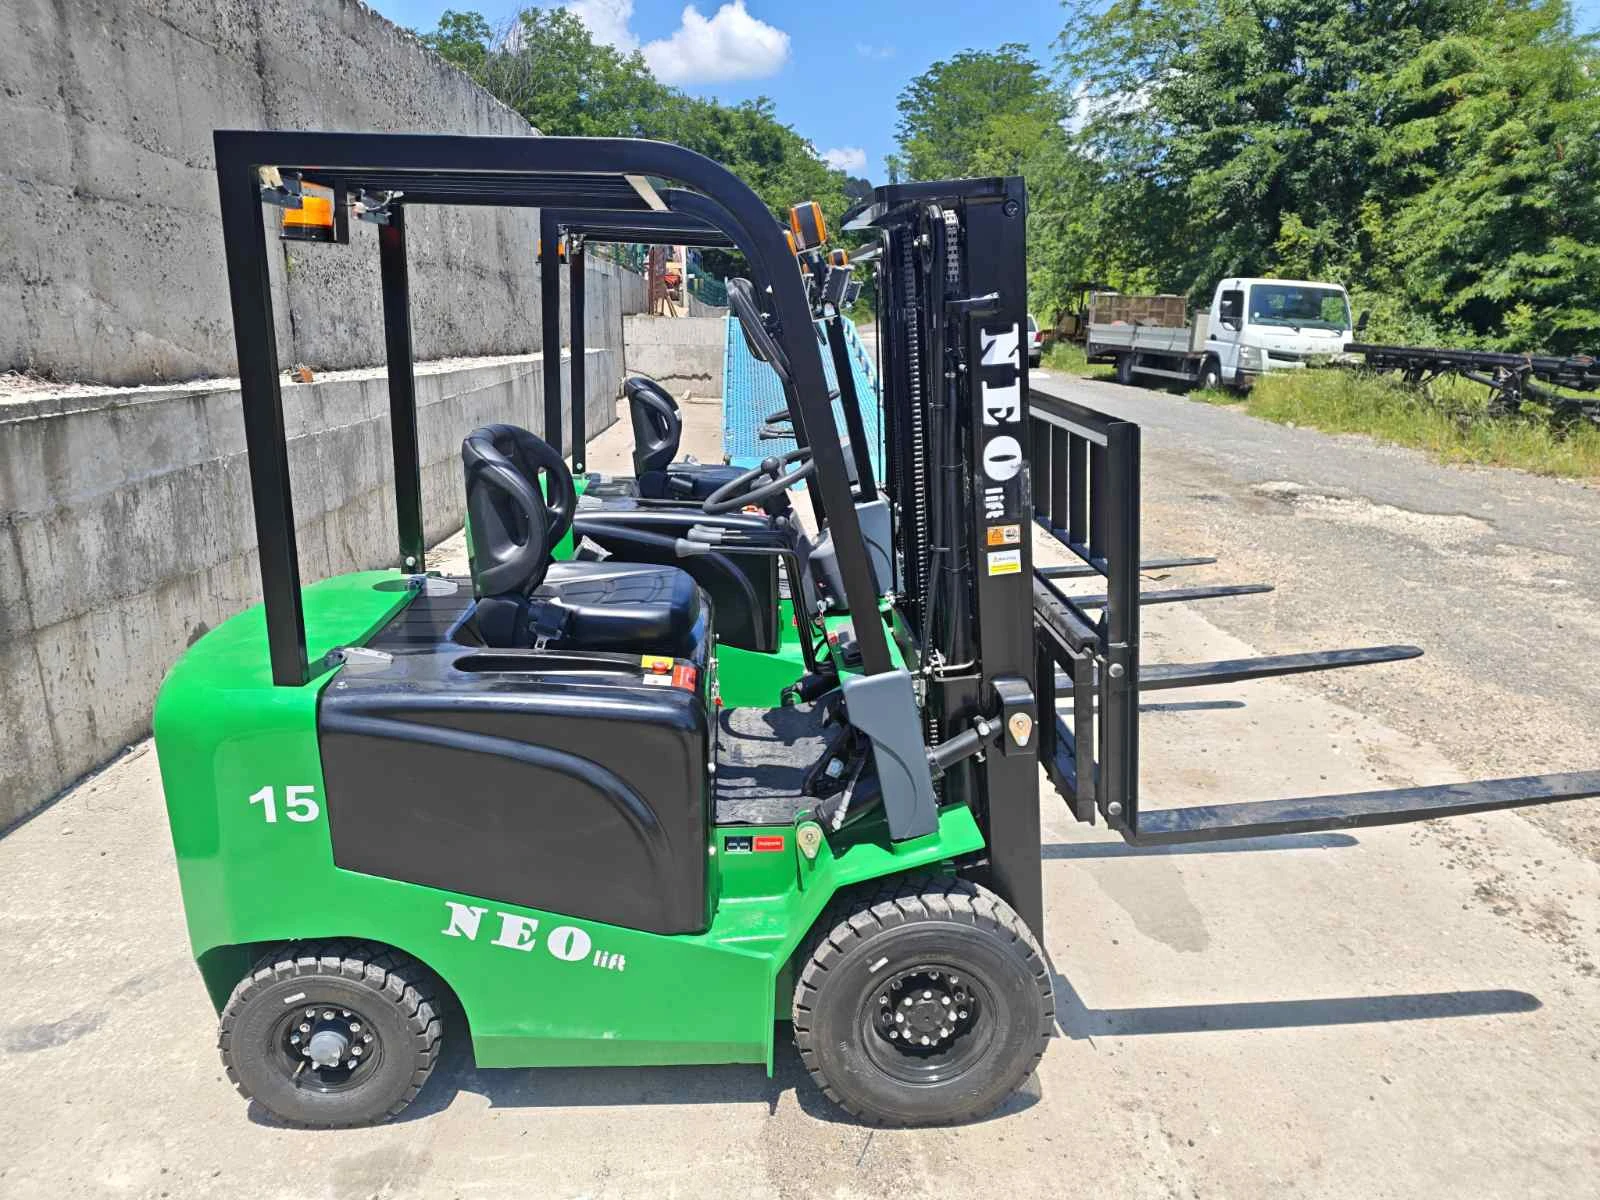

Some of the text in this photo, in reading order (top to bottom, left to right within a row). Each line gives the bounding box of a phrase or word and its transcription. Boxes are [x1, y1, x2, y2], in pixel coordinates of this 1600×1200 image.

[980, 322, 1022, 481] NEO
[984, 486, 1005, 519] lift
[249, 785, 320, 822] 15
[441, 901, 626, 972] NEO lift
